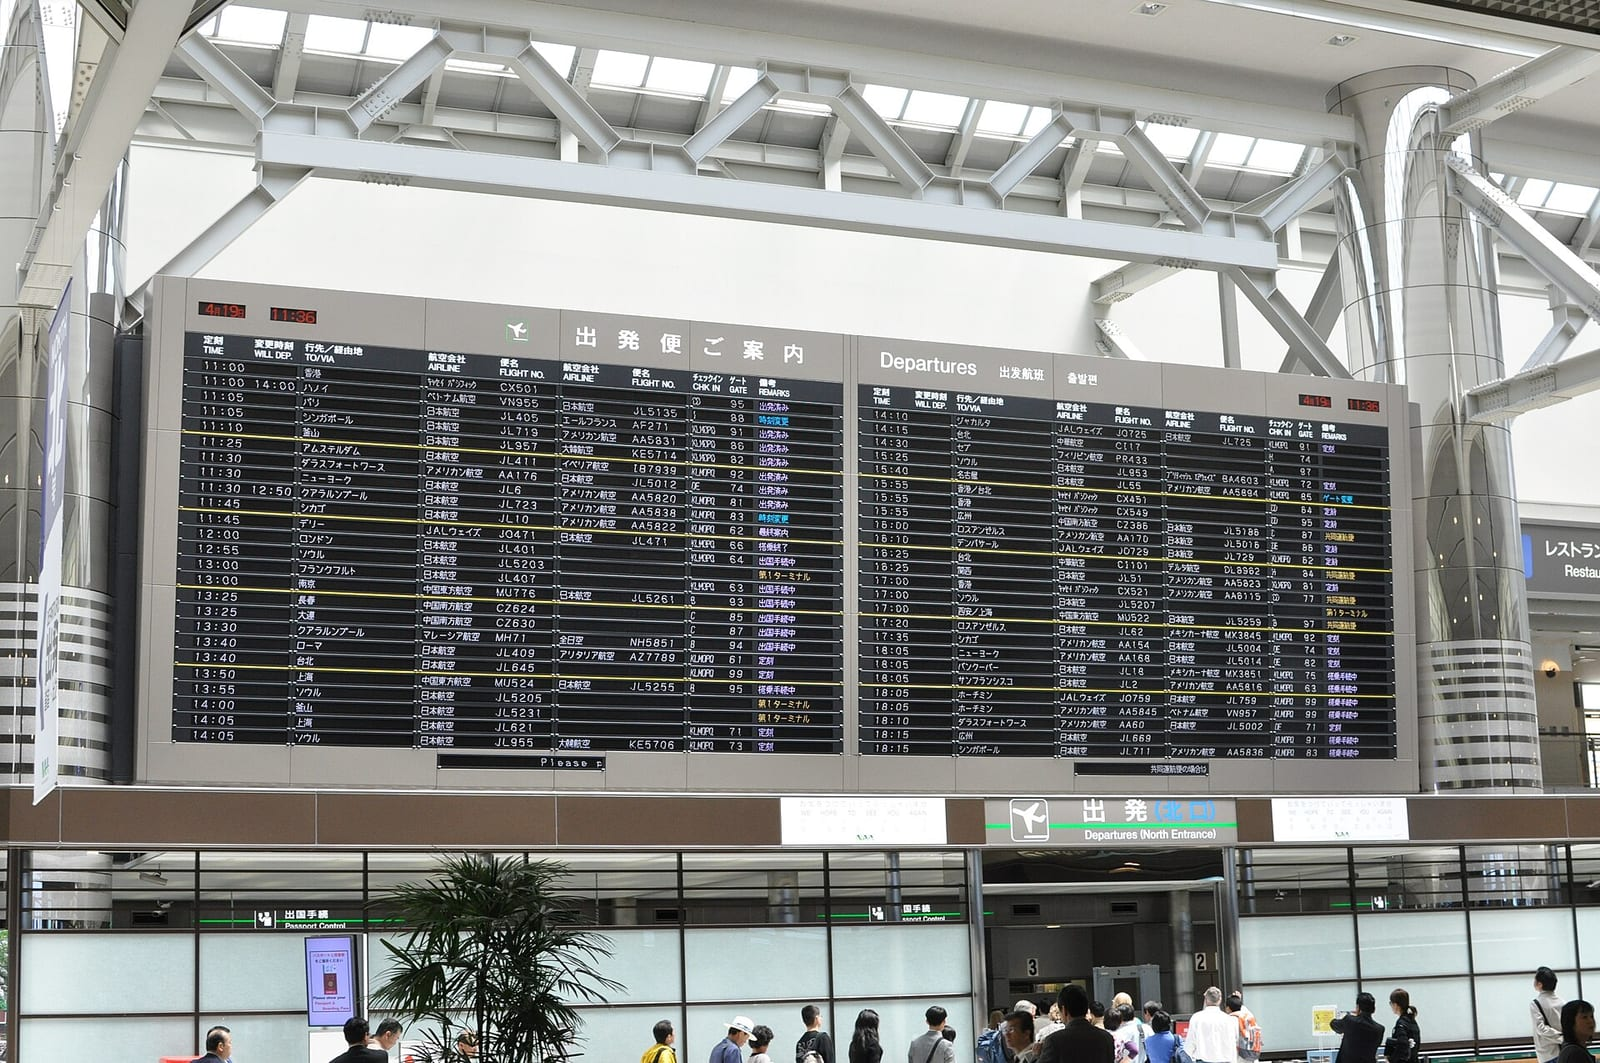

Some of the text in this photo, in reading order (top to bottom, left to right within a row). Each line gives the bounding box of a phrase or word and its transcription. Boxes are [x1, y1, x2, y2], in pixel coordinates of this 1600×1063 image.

[272, 309, 315, 323] 11:36
[575, 327, 803, 364] 出発便ご案内
[203, 335, 223, 345] 定刻
[253, 339, 293, 350] 変更時刻
[428, 352, 465, 363] 航空会社
[499, 357, 518, 367] 便名
[563, 362, 599, 373] 航空会社
[632, 367, 650, 377] 便名
[692, 372, 722, 383] チェックイン
[729, 375, 746, 384] ゲート
[880, 352, 977, 376] Departures
[202, 346, 224, 355] TIME
[253, 349, 272, 358] WILL
[274, 351, 293, 360] DEP.
[304, 353, 335, 363] TO/VIA
[428, 362, 460, 372] AIRLINE
[499, 368, 528, 377] FLIGHT
[530, 370, 544, 378] NO.
[562, 372, 594, 382] AIRLINE
[632, 378, 659, 387] FLIGHT
[661, 380, 675, 388] NO.
[692, 382, 709, 391] CHK
[729, 385, 747, 393] GATE
[758, 387, 789, 396] REMARKS
[1000, 366, 1045, 381] 出发航班
[1068, 373, 1098, 385] 출발편
[204, 376, 744, 422] 11:00 14:00 ハノイ ベトナム航空 VN955 JL5135 88
[1349, 400, 1379, 411] 11:36
[873, 397, 890, 405] TIME
[914, 400, 930, 408] WILL
[932, 401, 946, 409] DEP.
[956, 403, 981, 412] TO/VIA
[1056, 411, 1083, 420] AIRLINE
[1114, 416, 1138, 424] FLIGHT
[1165, 420, 1190, 428] AIRLINE
[1219, 424, 1242, 432] FLIGHT
[1298, 430, 1312, 438] GATE
[1321, 432, 1346, 440] REMARKS
[875, 410, 907, 420] 14:10
[202, 436, 743, 479] 11:25 アムステルダム JL411 イベリア航空 92
[1117, 481, 1140, 489] JL55
[201, 482, 240, 493] 11:30
[252, 485, 291, 496] 12:50
[498, 499, 536, 509] JL723
[631, 506, 676, 517] AA5838
[729, 511, 743, 521] 83
[200, 513, 239, 524] 11:45
[299, 518, 324, 528] デリー
[426, 525, 481, 536] JALウェイズ
[632, 536, 666, 545] JL471
[729, 541, 743, 549] 66
[198, 559, 743, 592] 13:00 フランクフルト 日本航空 JL407 63
[196, 621, 236, 632] 13:30
[423, 630, 480, 641] マレーシア航空
[495, 633, 525, 642] MH71
[629, 637, 673, 647] NH5851
[728, 640, 742, 649] 94
[875, 618, 908, 627] 17:20
[1119, 627, 1143, 636] JL62
[1224, 631, 1261, 640] MX3845
[1303, 633, 1315, 641] 92
[296, 641, 322, 650] ローマ
[496, 648, 534, 657] JL409
[629, 652, 675, 662] AZ7789
[728, 655, 741, 664] 61
[875, 646, 1150, 662] 18:05 ニューヨーク AA168
[957, 690, 992, 699] ホーチミン
[1060, 693, 1106, 701] JALウェイズ
[1169, 694, 1195, 703] 日本航空
[1226, 696, 1256, 704] JL759
[1305, 697, 1316, 705] 99
[876, 716, 908, 724] 18:10
[958, 717, 1025, 727] ダラスフォートワース
[1060, 717, 1106, 728] アメリカン航空
[1119, 720, 1145, 729] AA60
[1227, 722, 1262, 730] JL5002
[194, 730, 233, 740] 14:05
[295, 733, 320, 742] ソウル
[420, 735, 453, 745] 日本航空
[493, 736, 533, 746] JL955
[629, 739, 673, 749] KE5706
[729, 741, 742, 750] 73
[876, 744, 1317, 756] 18:15 JL711 AA5836 83
[541, 757, 587, 767] Please
[1084, 829, 1216, 841] Departures (North Entrance)
[1028, 958, 1037, 976] 3
[1196, 953, 1205, 970] 2
